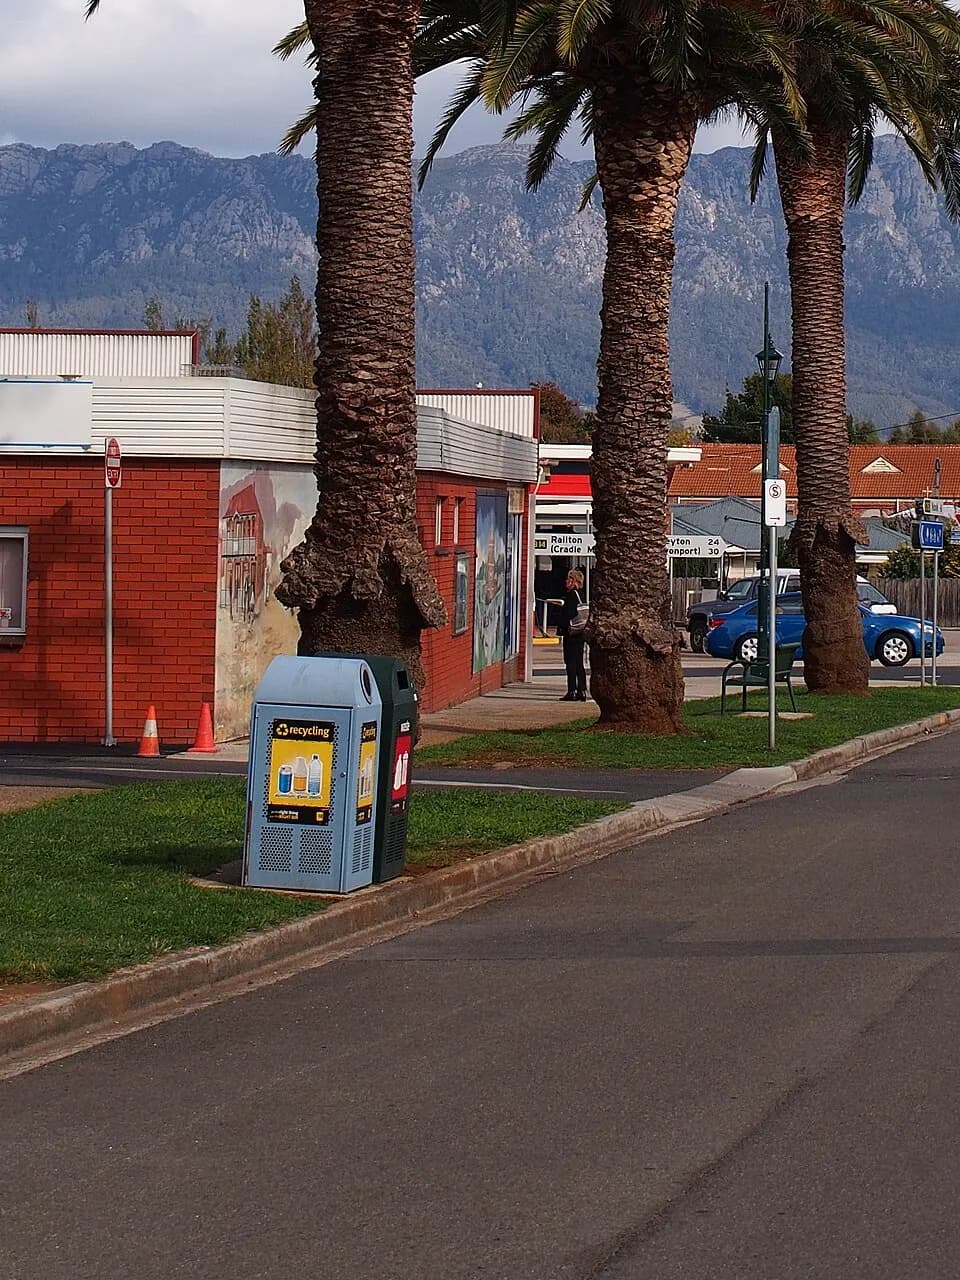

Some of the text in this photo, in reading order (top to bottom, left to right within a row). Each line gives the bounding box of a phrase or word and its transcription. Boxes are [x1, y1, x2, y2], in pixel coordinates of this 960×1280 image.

[551, 535, 583, 544] Railton
[707, 538, 720, 546] 24
[550, 544, 582, 554] (Cradle
[289, 723, 330, 738] recycling
